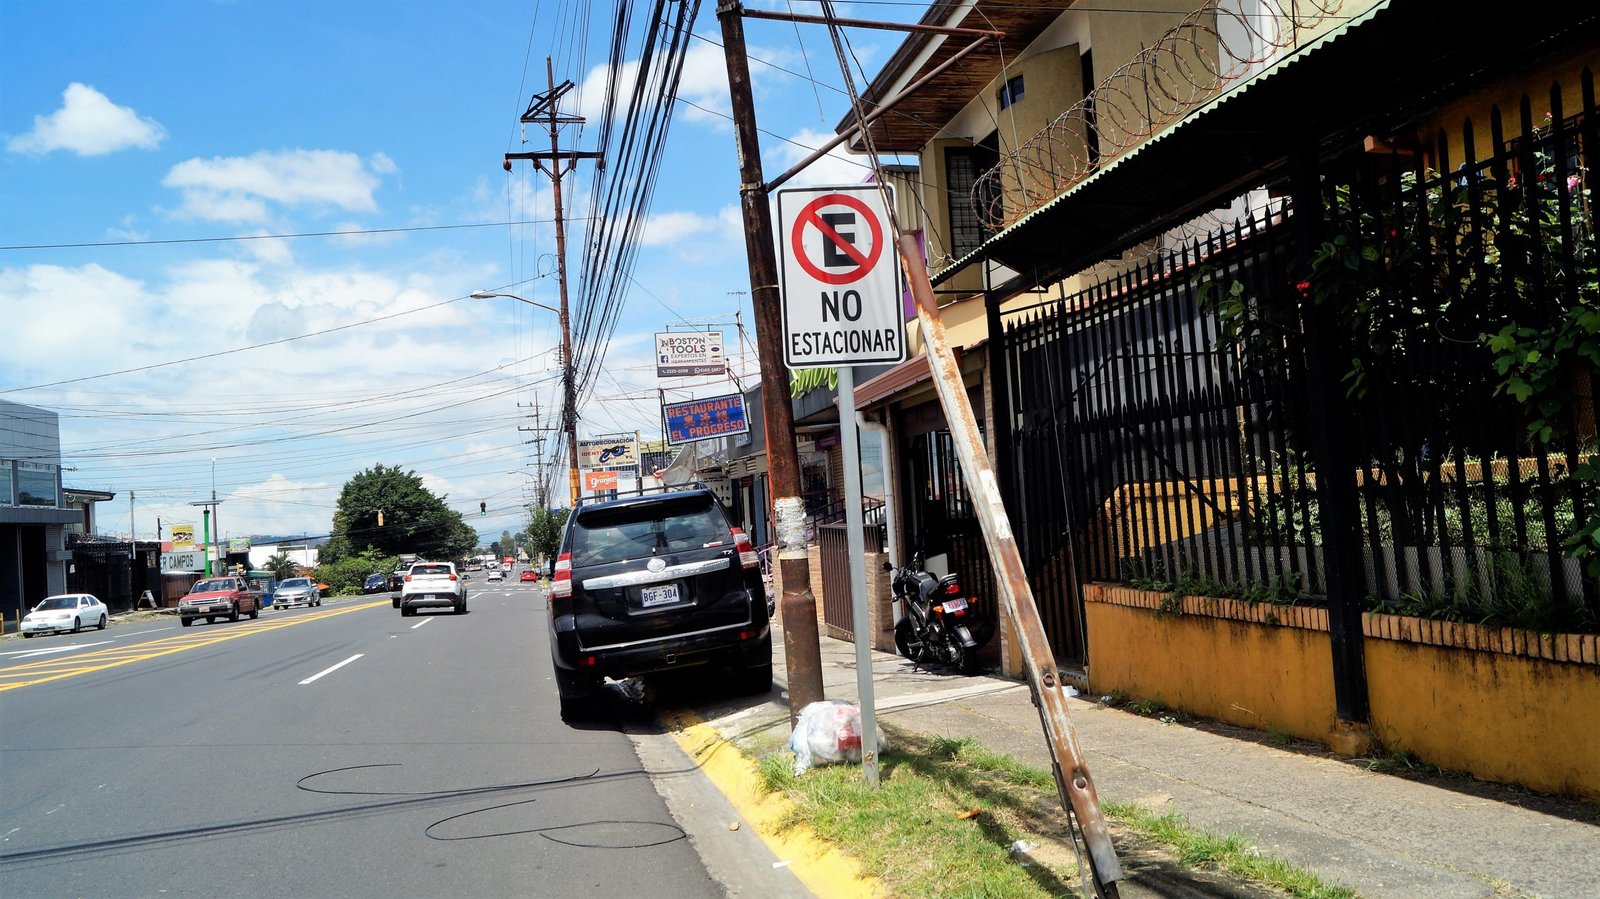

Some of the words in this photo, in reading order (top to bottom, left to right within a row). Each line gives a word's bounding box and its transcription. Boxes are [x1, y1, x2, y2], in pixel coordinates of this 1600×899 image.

[821, 290, 862, 323] NO
[669, 337, 706, 345] BOSTON
[670, 345, 706, 354] TOOLS
[792, 329, 896, 356] ESTACIONAR
[667, 397, 741, 418] RESTAURANTE
[671, 430, 686, 441] EL
[689, 419, 745, 437] PROGRESO
[580, 437, 635, 447] AUTODECORACIÓN
[169, 554, 194, 570] CAMPOS
